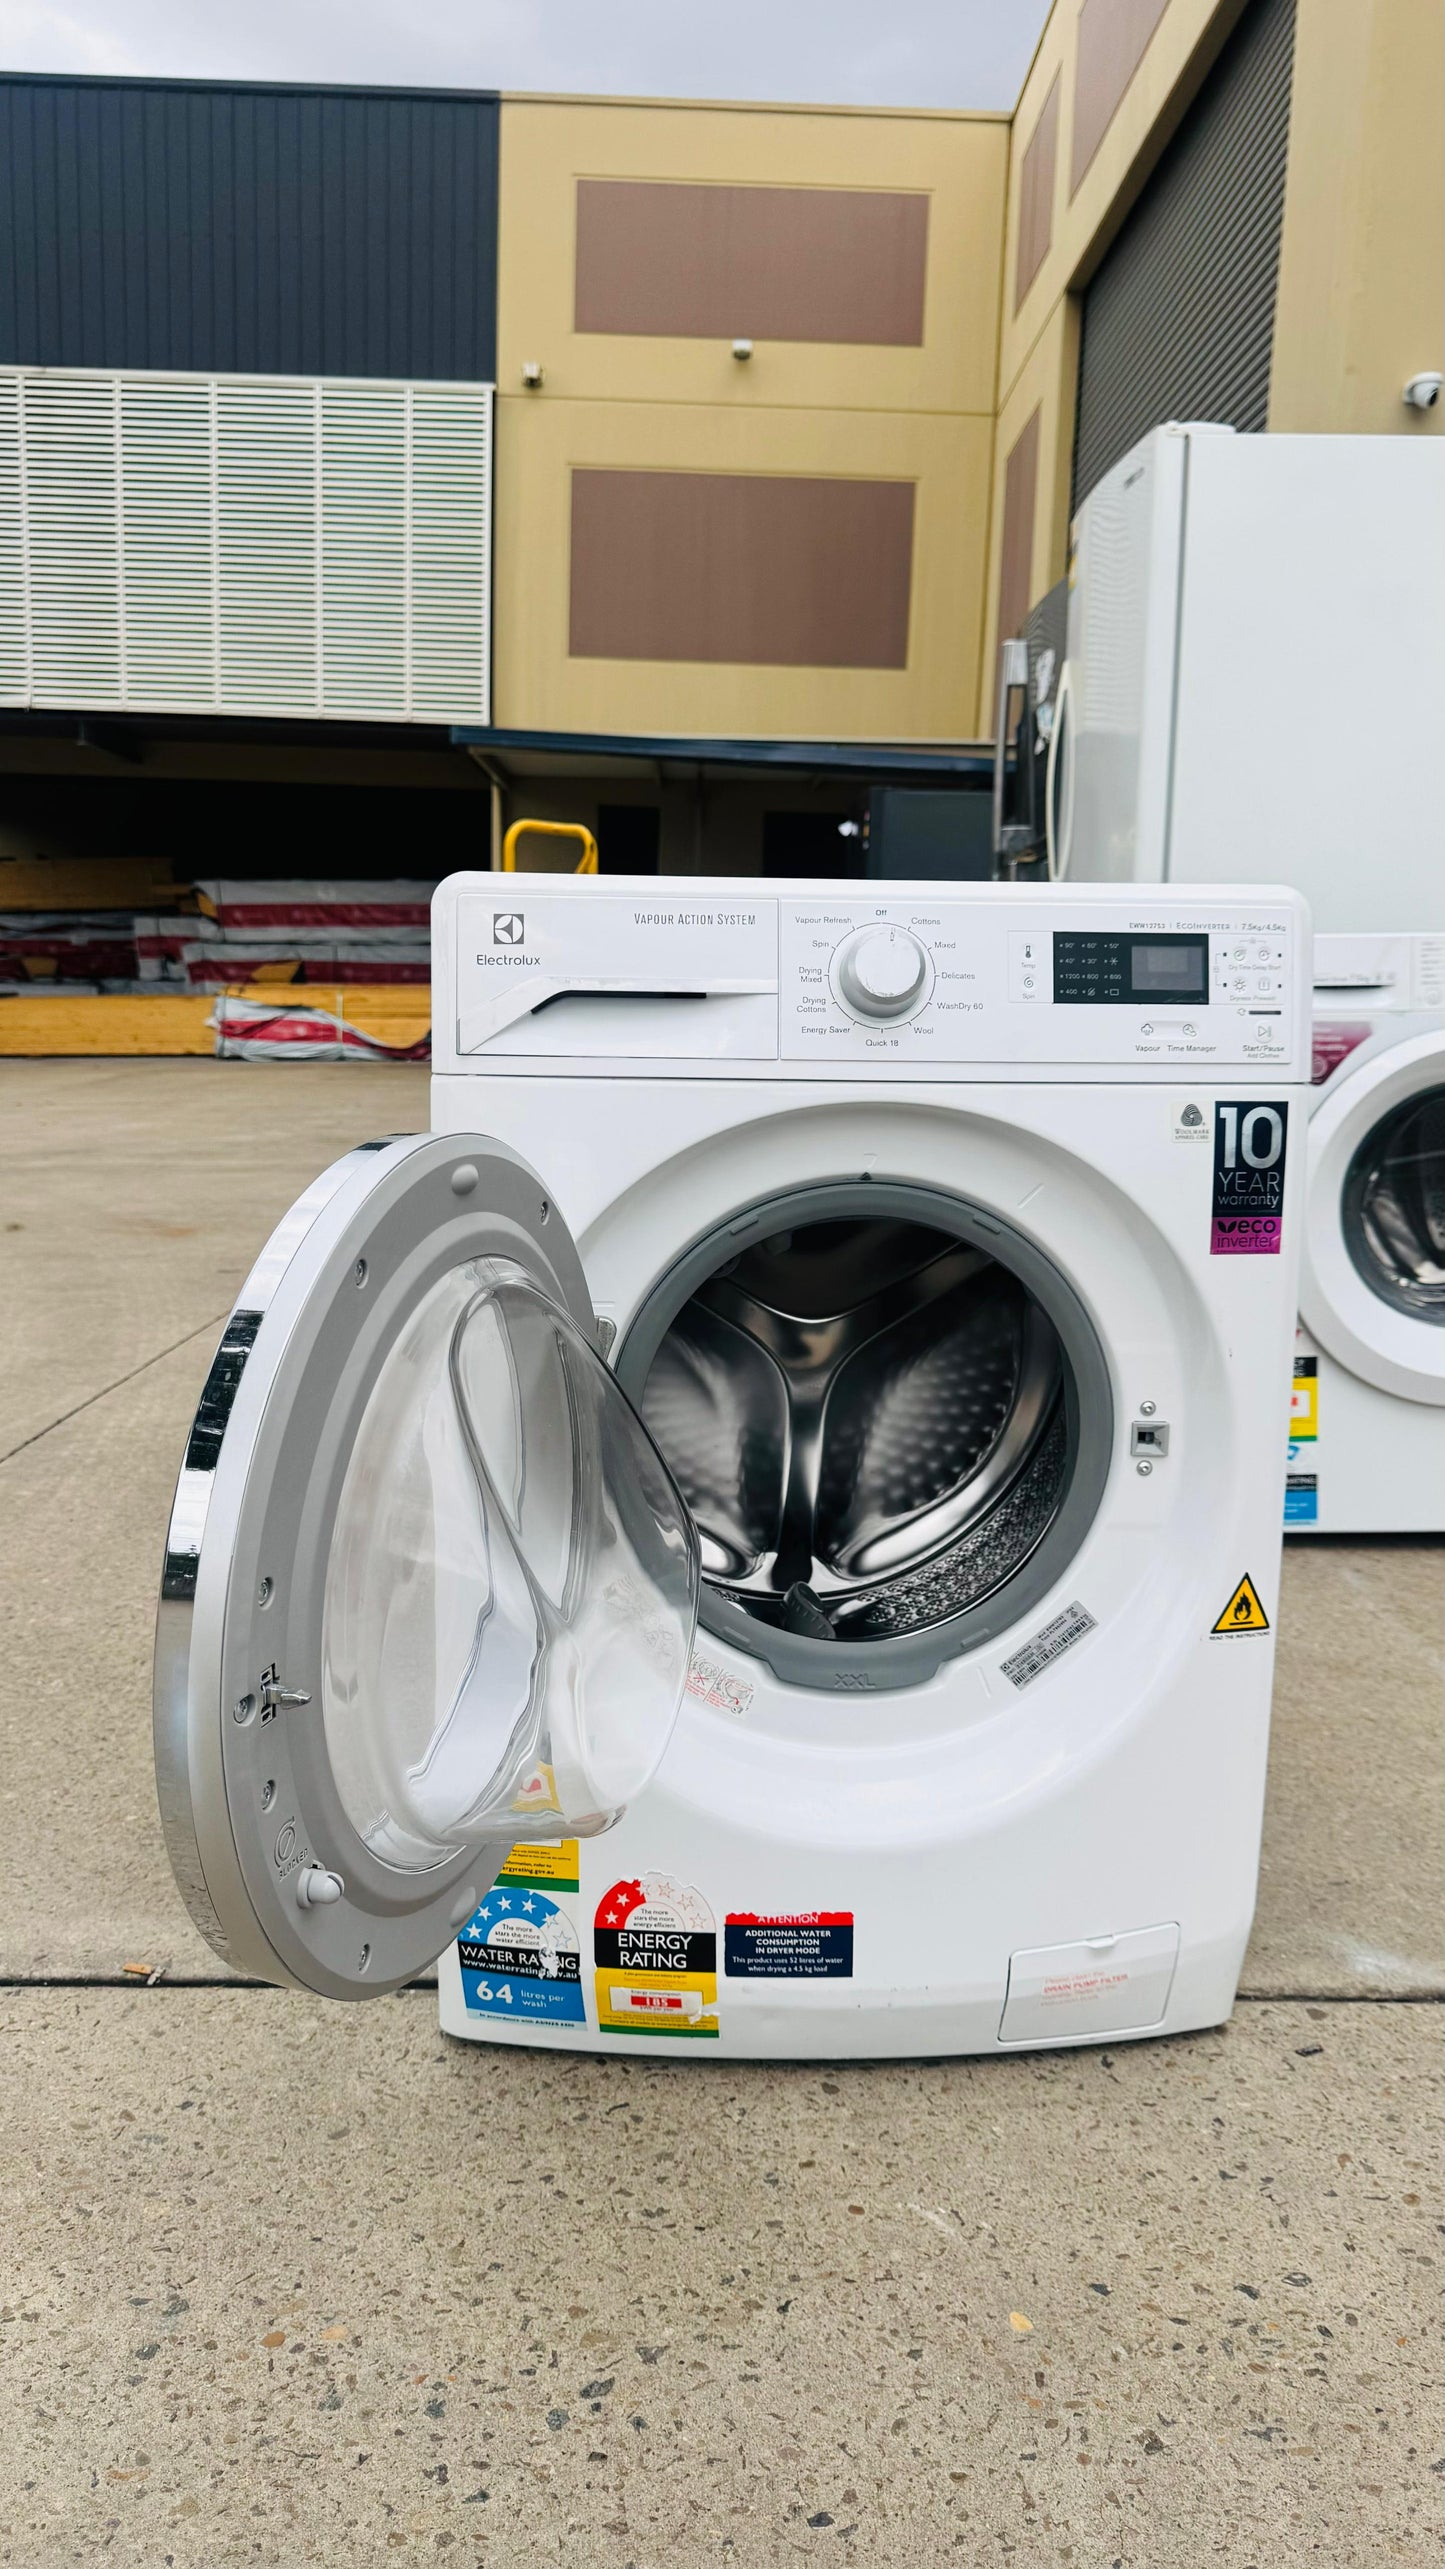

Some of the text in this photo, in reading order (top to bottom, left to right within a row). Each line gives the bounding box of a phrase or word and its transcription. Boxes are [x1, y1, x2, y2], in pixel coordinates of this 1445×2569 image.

[795, 916, 821, 925] Vapour
[911, 917, 941, 925] Cottons
[812, 940, 829, 949] Spin
[934, 941, 956, 949] Mixed
[476, 954, 541, 966] Electrolux
[799, 967, 822, 976] Drying
[941, 972, 975, 980] Delicates
[800, 975, 823, 983] Mixed
[802, 996, 826, 1006] Drying
[796, 1005, 826, 1013] Cottons
[801, 1026, 850, 1035] Energy Saver
[914, 1027, 934, 1035] Wool
[865, 1039, 888, 1047] Quick
[1219, 1106, 1283, 1169] 10
[1218, 1171, 1280, 1193] YEAR
[1217, 1193, 1279, 1208] warranty
[1237, 1219, 1276, 1234] eco
[1217, 1235, 1277, 1248] inverter
[834, 1673, 876, 1688] XXL
[800, 1930, 832, 1938] WATER
[618, 1932, 693, 1950] ENERGY
[756, 1938, 820, 1946] CONSUMPTION
[461, 1945, 577, 1970] WATER RANG
[620, 1950, 687, 1969] RATING
[747, 1956, 772, 1964] product
[816, 1956, 824, 1964] of
[767, 1965, 787, 1973] drying
[476, 1980, 513, 2004] 64
[520, 1989, 565, 2002] litres per
[522, 2000, 547, 2008] wash
